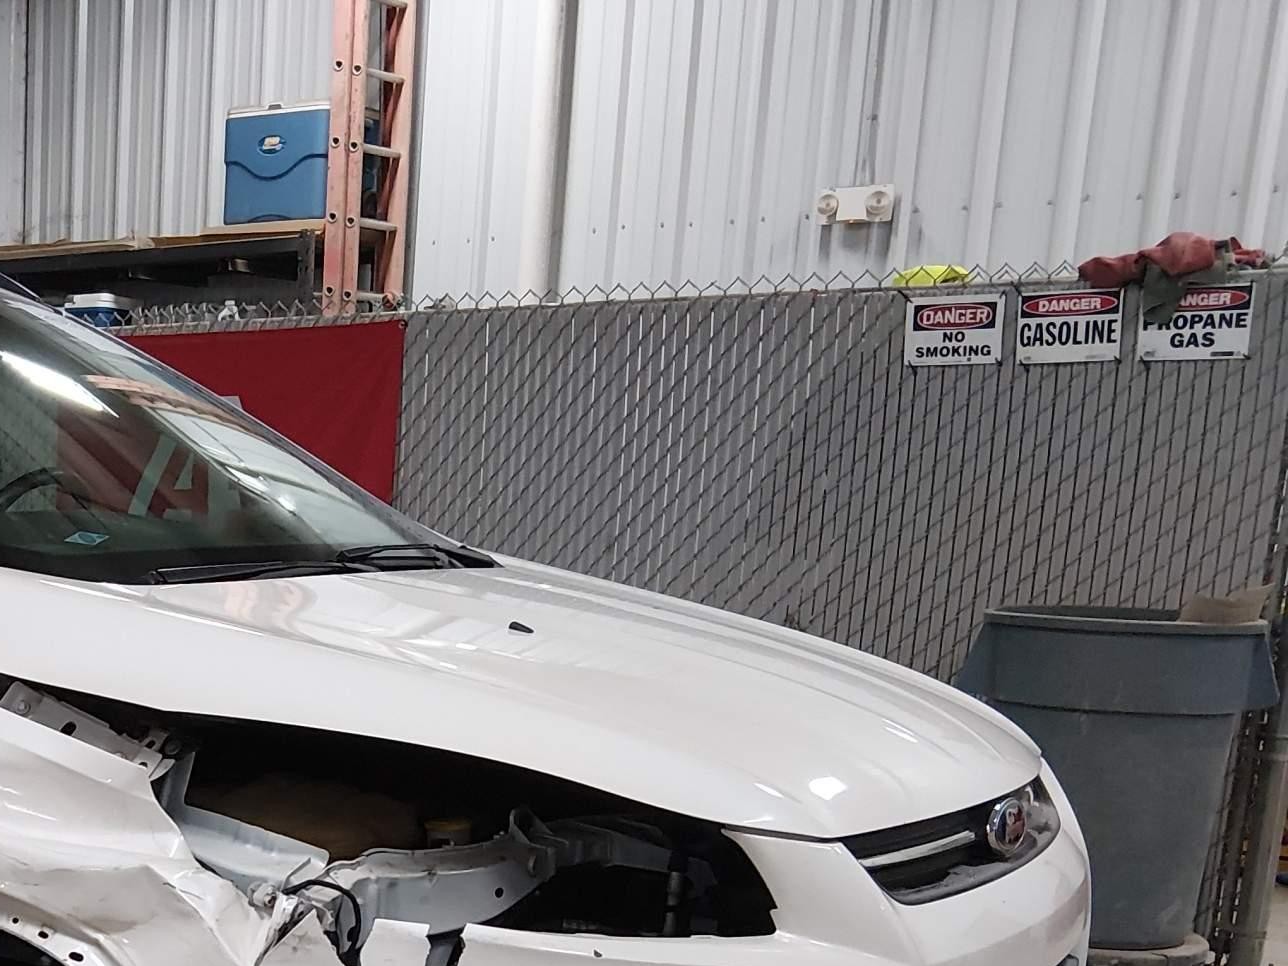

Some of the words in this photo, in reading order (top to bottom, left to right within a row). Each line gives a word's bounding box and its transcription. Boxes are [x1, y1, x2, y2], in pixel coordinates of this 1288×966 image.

[1038, 298, 1102, 312] DANGER
[922, 308, 988, 325] DANGER
[942, 331, 966, 343] NO
[1020, 319, 1118, 347] GASOLINE
[1169, 332, 1215, 348] GAS
[915, 345, 992, 358] SMOKING
